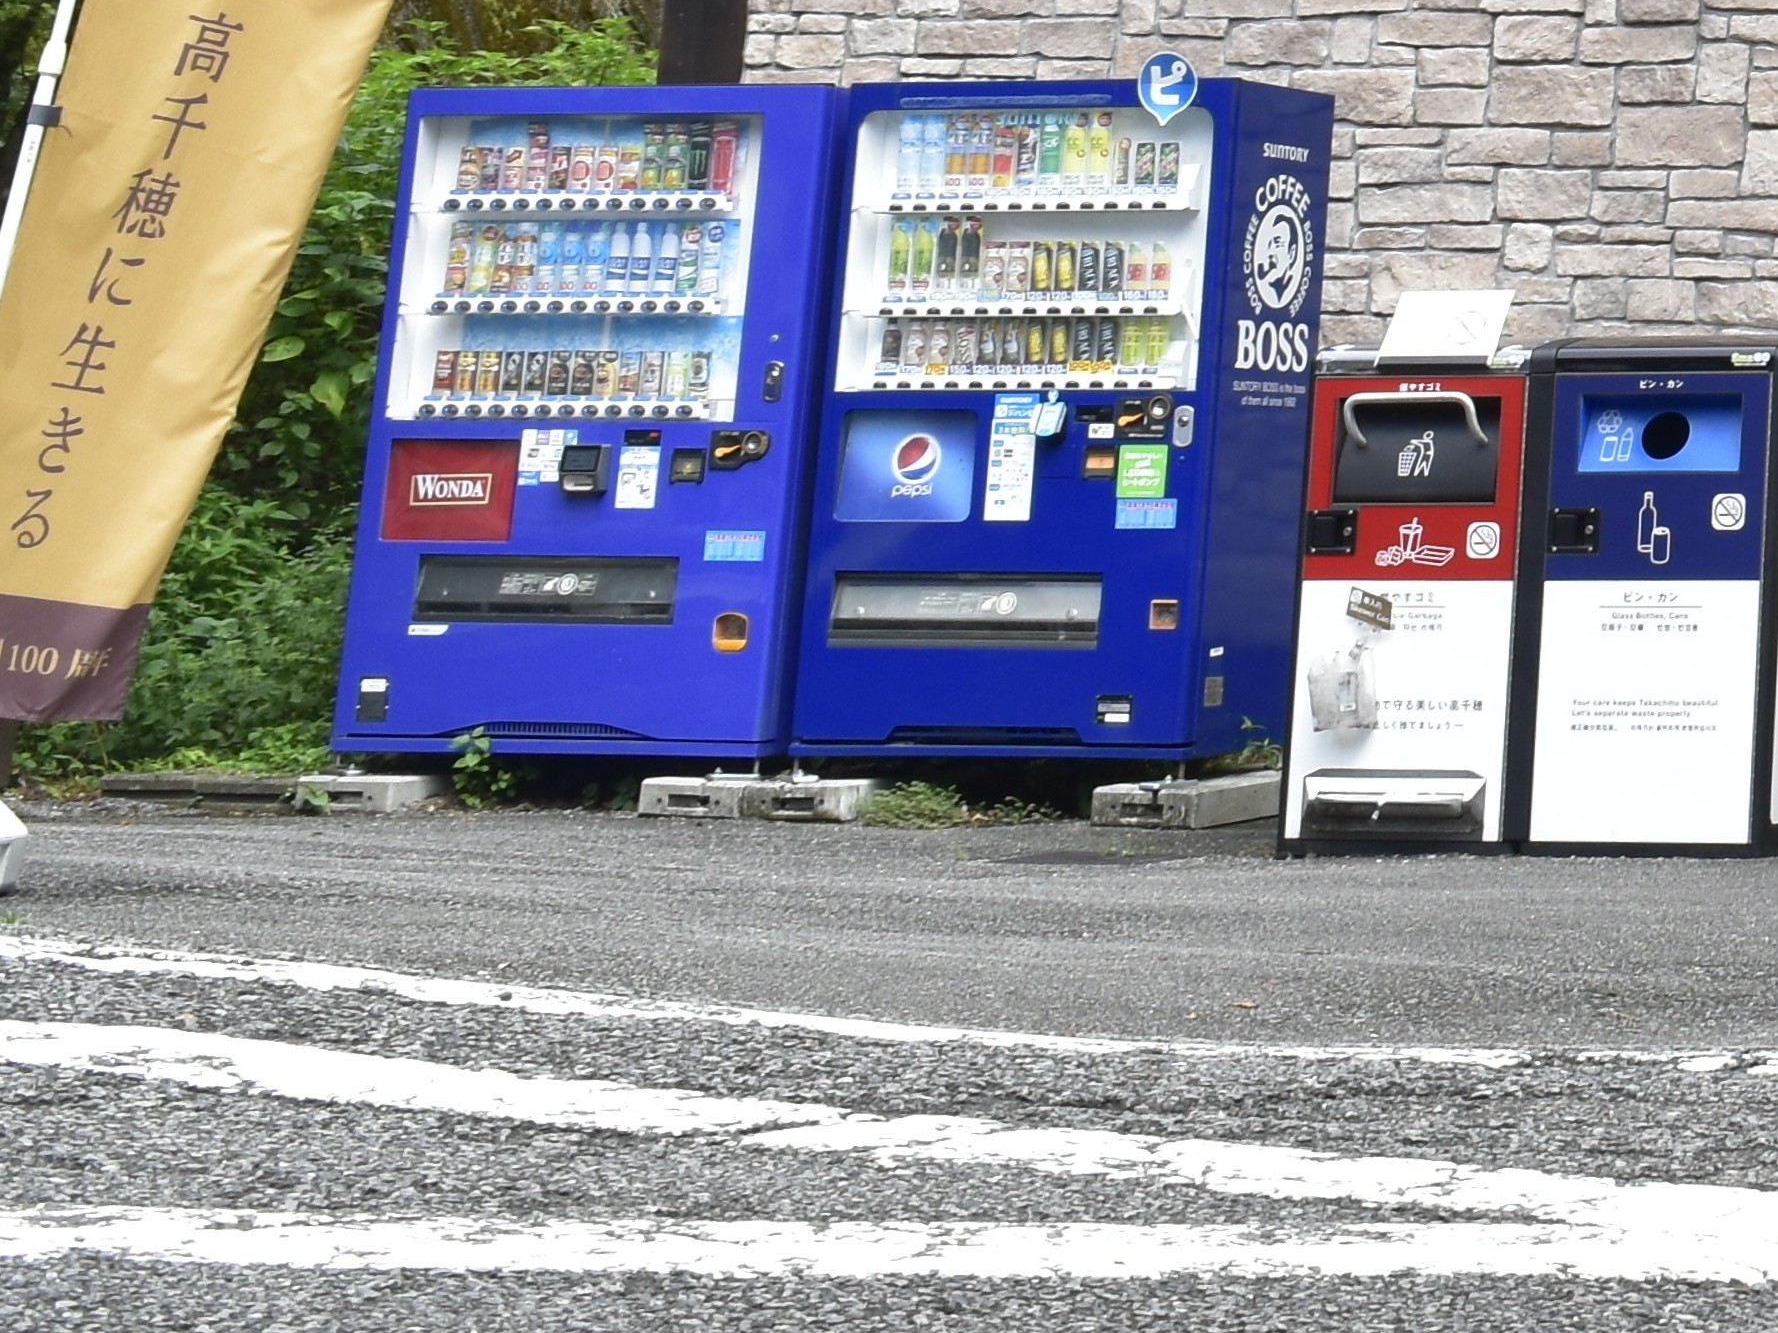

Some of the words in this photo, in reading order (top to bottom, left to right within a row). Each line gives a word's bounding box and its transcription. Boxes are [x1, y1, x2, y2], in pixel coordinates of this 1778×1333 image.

[1263, 142, 1309, 163] SUNTORY
[1255, 174, 1310, 221] COFFEE
[1243, 213, 1259, 273] COFFEE
[1302, 219, 1313, 262] BOSS
[11, 13, 244, 548] 高千穂に生きる
[1288, 265, 1313, 318] COFFEE
[1234, 319, 1309, 373] BOSS
[1640, 379, 1684, 389] ビン・カン
[415, 474, 484, 500] WONDA
[891, 484, 933, 498] pepsi
[1623, 591, 1679, 603] ビン・カン
